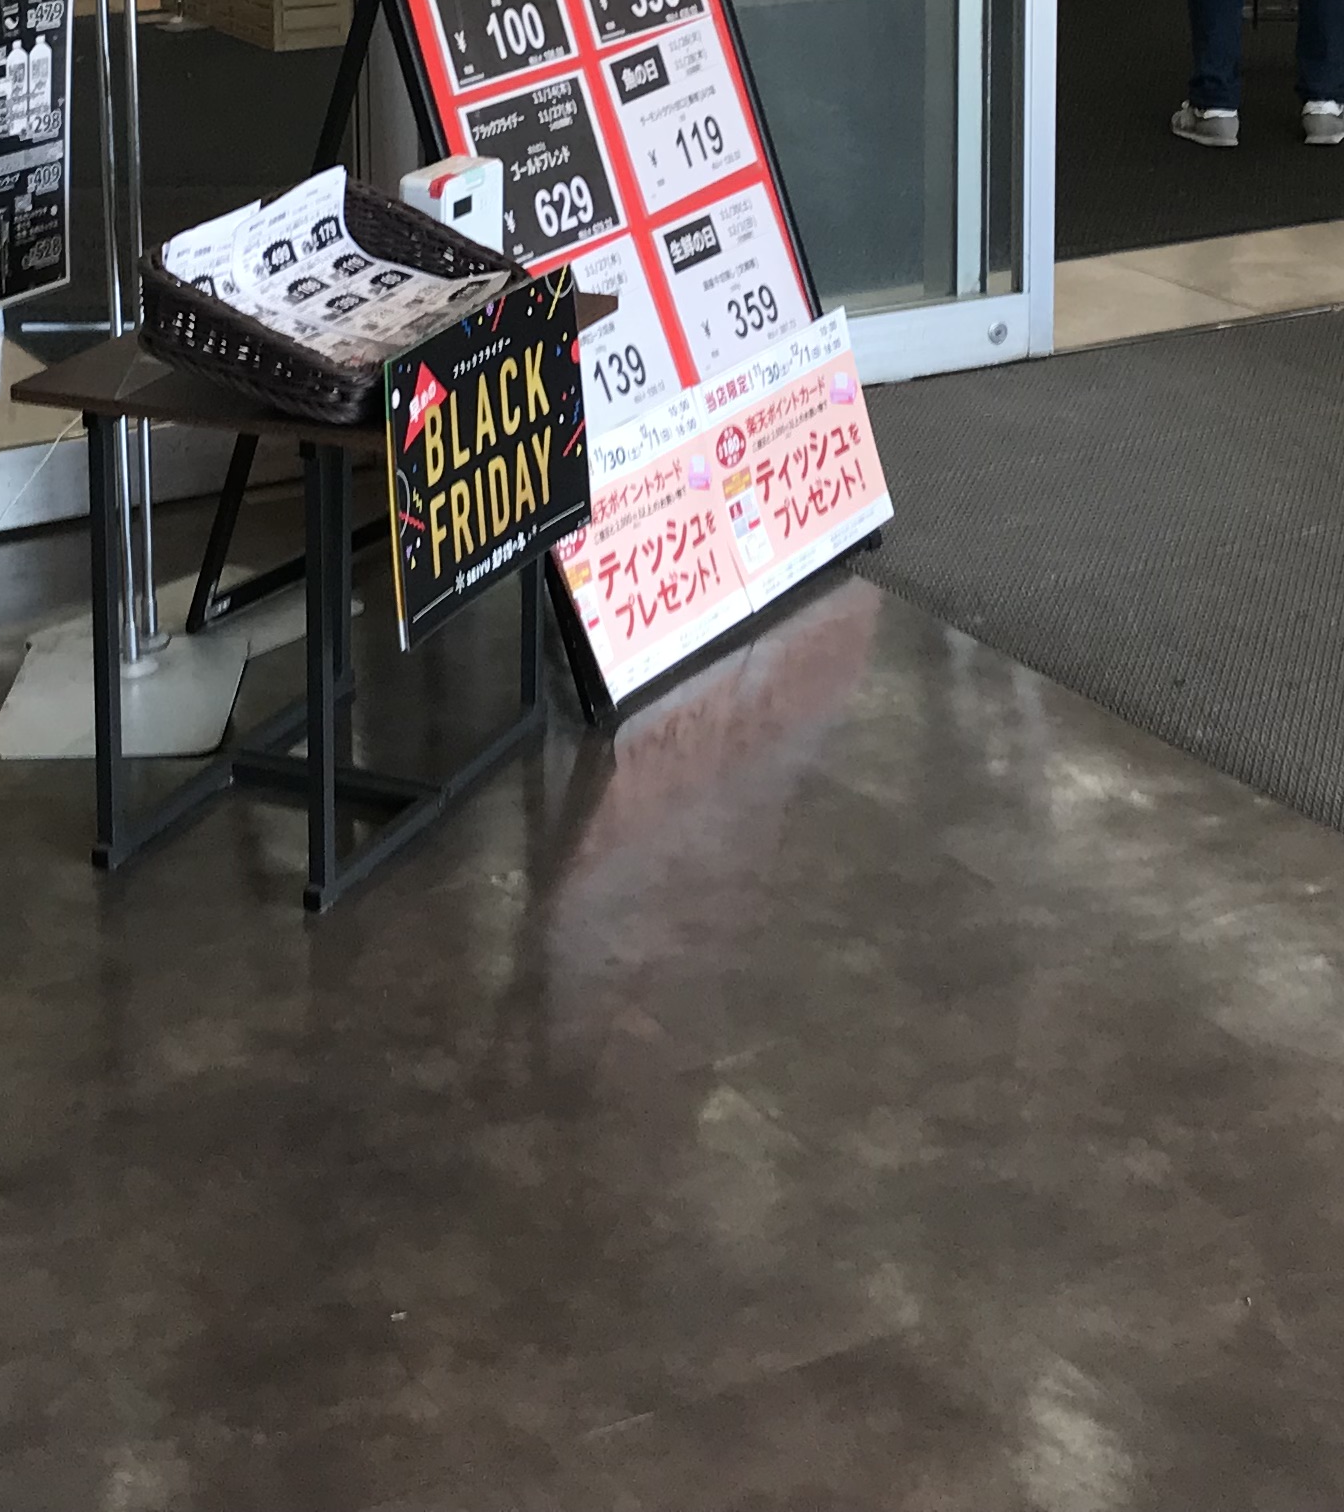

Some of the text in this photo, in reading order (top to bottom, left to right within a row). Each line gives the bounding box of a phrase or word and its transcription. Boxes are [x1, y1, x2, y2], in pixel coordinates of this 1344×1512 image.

[486, 1, 546, 61] 100
[35, 163, 61, 183] 409
[676, 115, 724, 169] 119
[534, 174, 595, 238] 629
[727, 284, 779, 339] 359
[408, 379, 437, 424] 早めの
[594, 344, 647, 403] 139
[424, 340, 551, 488] BLACK
[755, 421, 862, 503] ティッシュを
[429, 425, 552, 580] FRIDAY
[773, 458, 867, 539] プレゼント!
[465, 561, 492, 588] SEIYU
[598, 508, 717, 602] ティッシュを
[615, 548, 722, 640] プレゼント!
